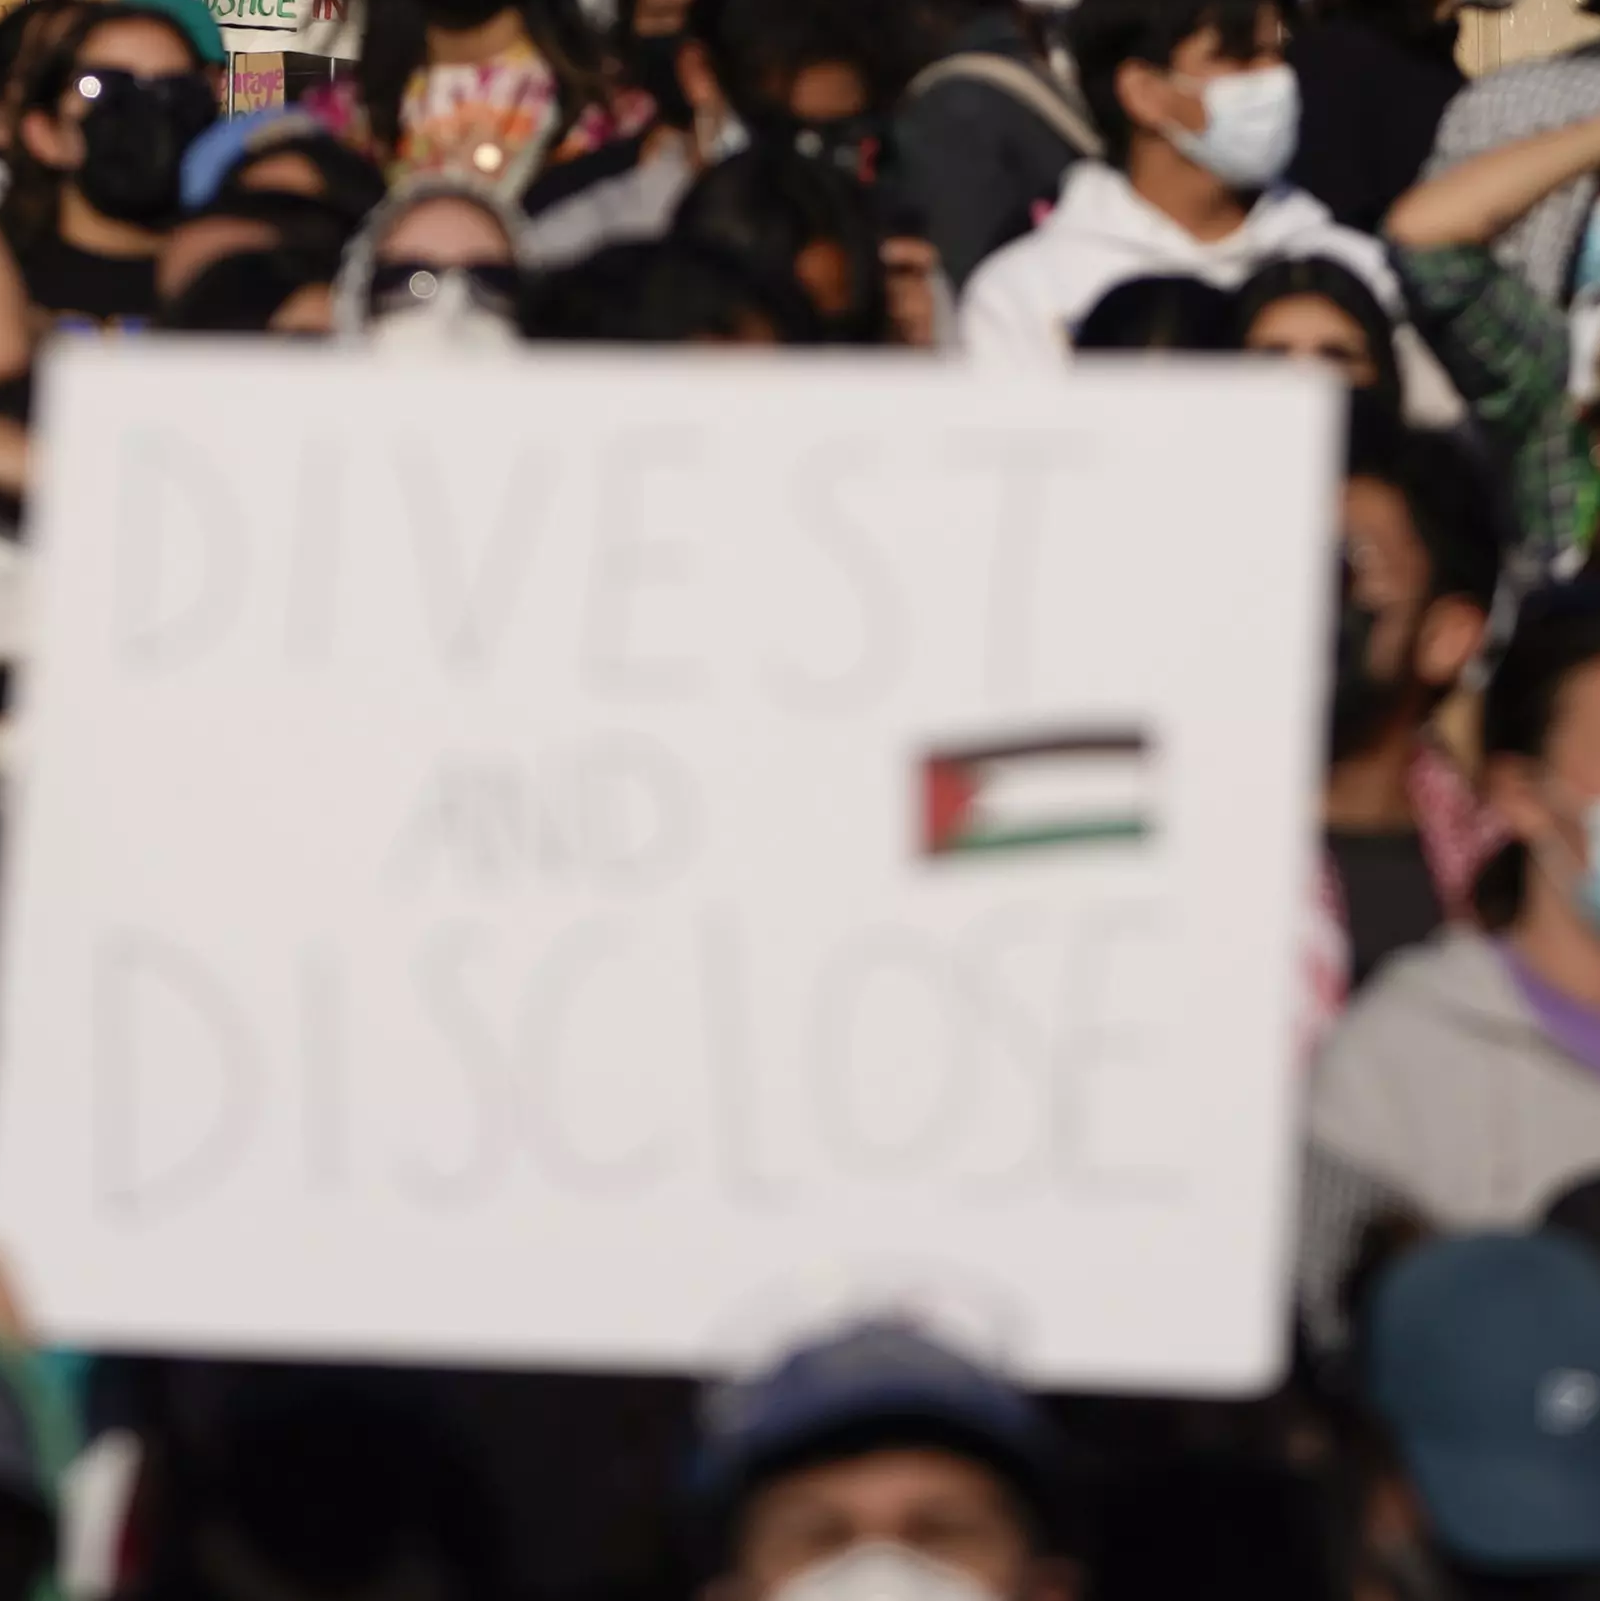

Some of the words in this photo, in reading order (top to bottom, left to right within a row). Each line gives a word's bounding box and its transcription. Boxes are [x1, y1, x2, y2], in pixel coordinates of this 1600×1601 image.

[109, 420, 1111, 720] DIVEST
[379, 728, 710, 899] AND
[91, 893, 1200, 1230] DISCLOSE
